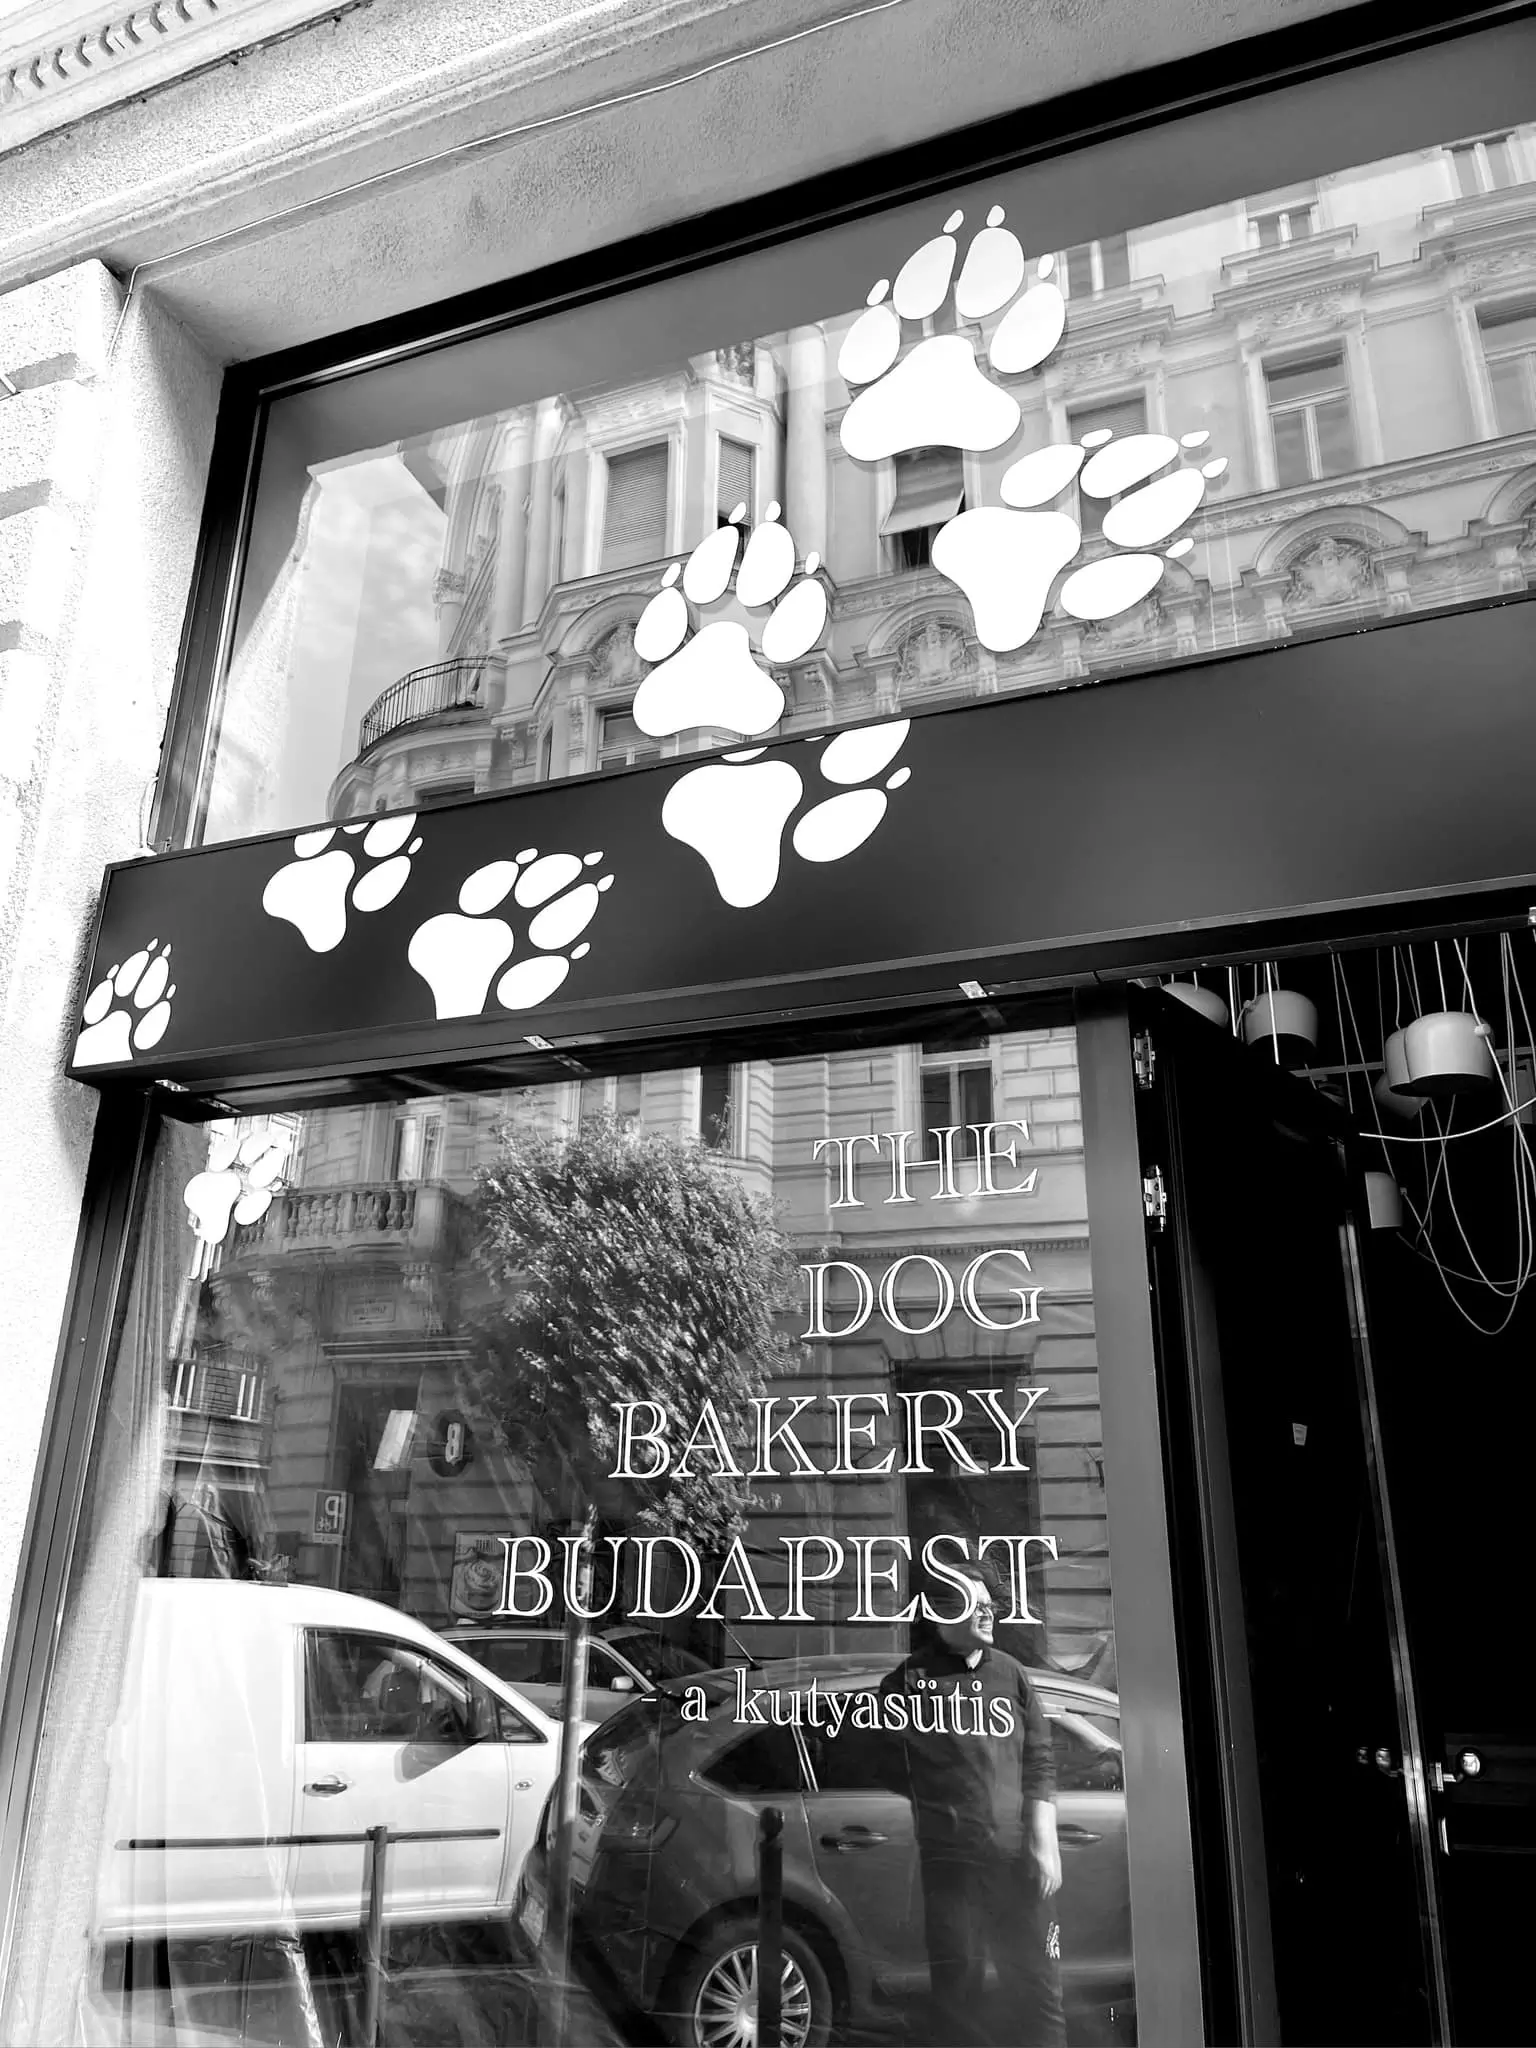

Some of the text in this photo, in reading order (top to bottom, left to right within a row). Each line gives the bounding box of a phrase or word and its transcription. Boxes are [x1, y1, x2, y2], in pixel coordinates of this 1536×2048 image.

[812, 1119, 1038, 1208] THE
[800, 1248, 1044, 1339] DOG
[607, 1387, 1049, 1479] BAKERY
[492, 1534, 1058, 1625] BUDAPEST
[680, 1683, 708, 1723] a
[732, 1667, 1016, 1738] kutyasütis
